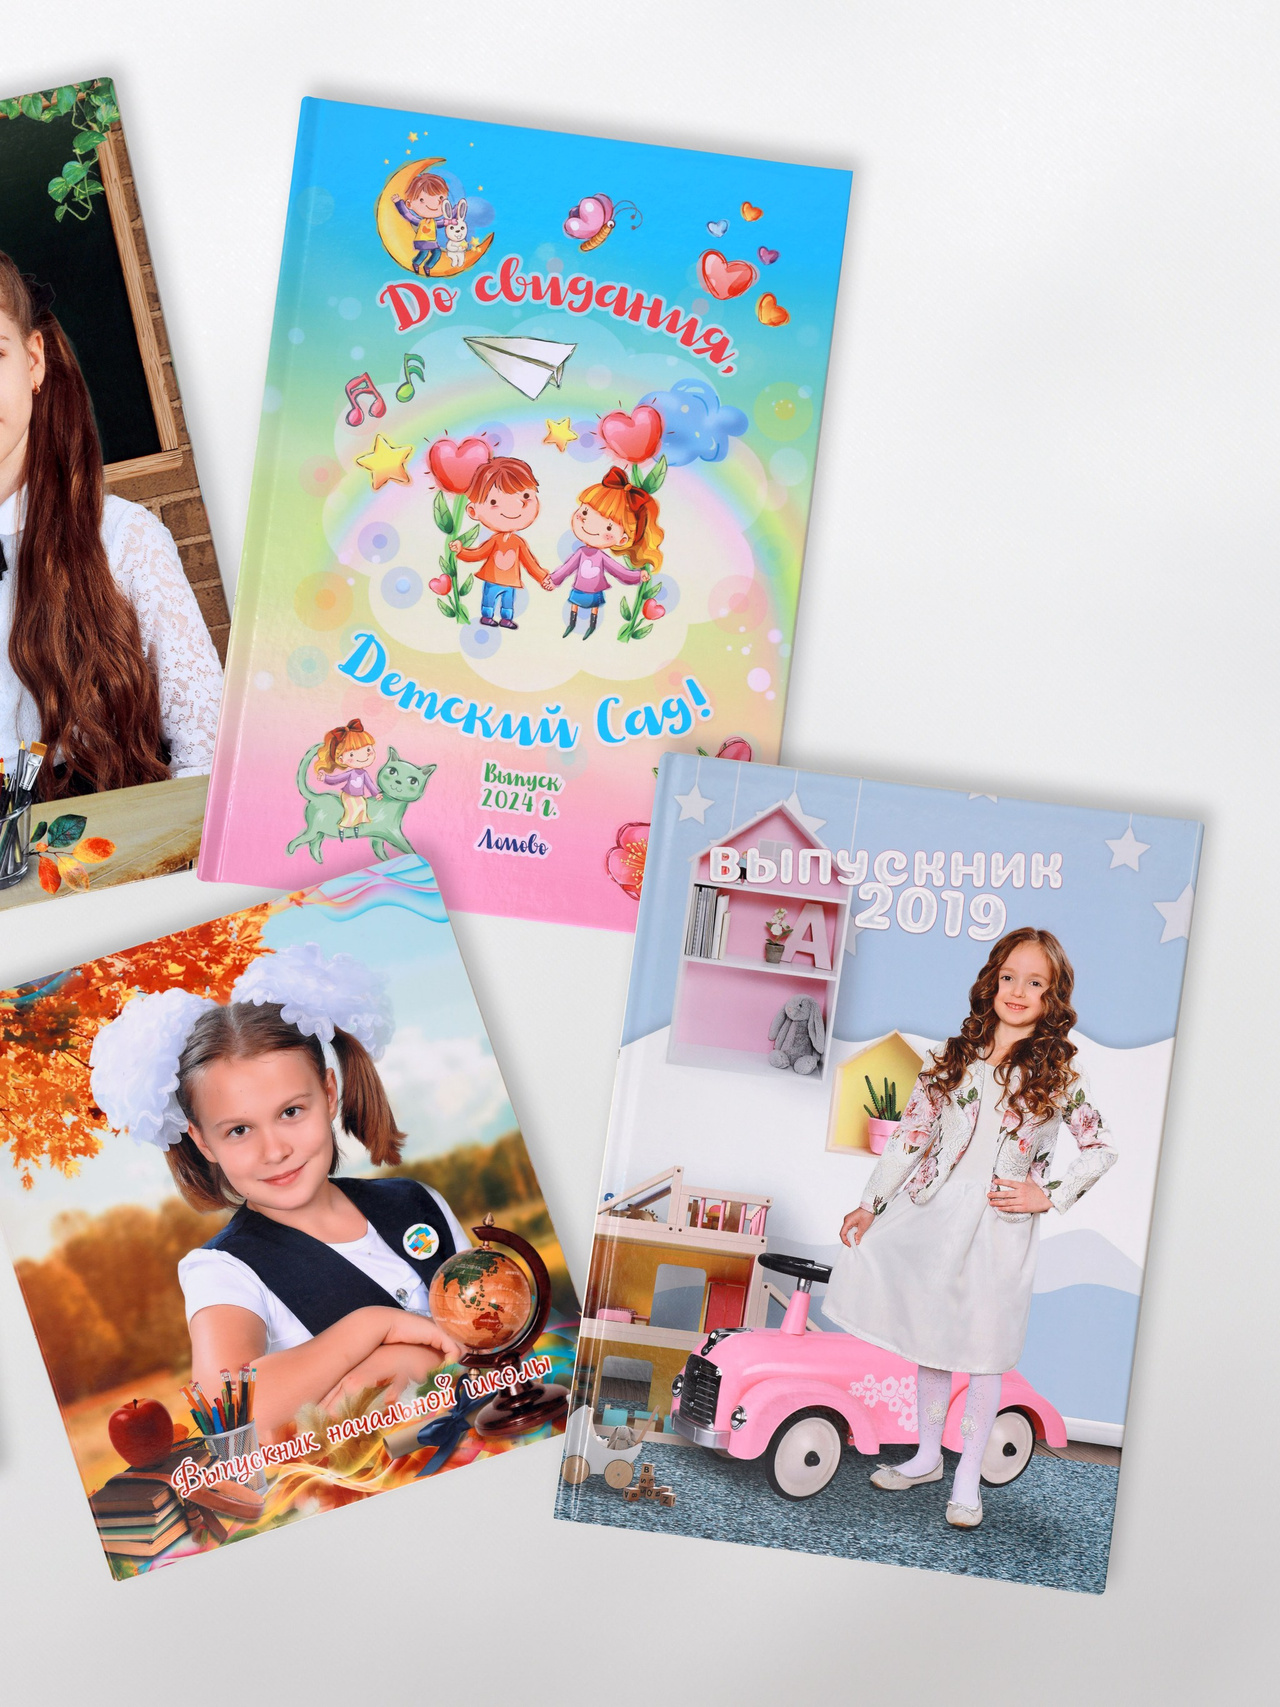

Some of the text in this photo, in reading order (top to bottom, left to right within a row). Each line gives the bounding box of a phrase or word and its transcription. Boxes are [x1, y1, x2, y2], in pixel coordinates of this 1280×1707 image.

[379, 256, 738, 374] До свидания,
[337, 632, 713, 749] Детский Сад!
[483, 762, 562, 792] Выпуск
[482, 789, 558, 817] 2024 г.
[477, 828, 549, 856] Ломово
[709, 846, 1064, 889] ВЫПУСКНИК
[854, 882, 1007, 941] 2019
[171, 1355, 553, 1498] Выпускник начальной школы
